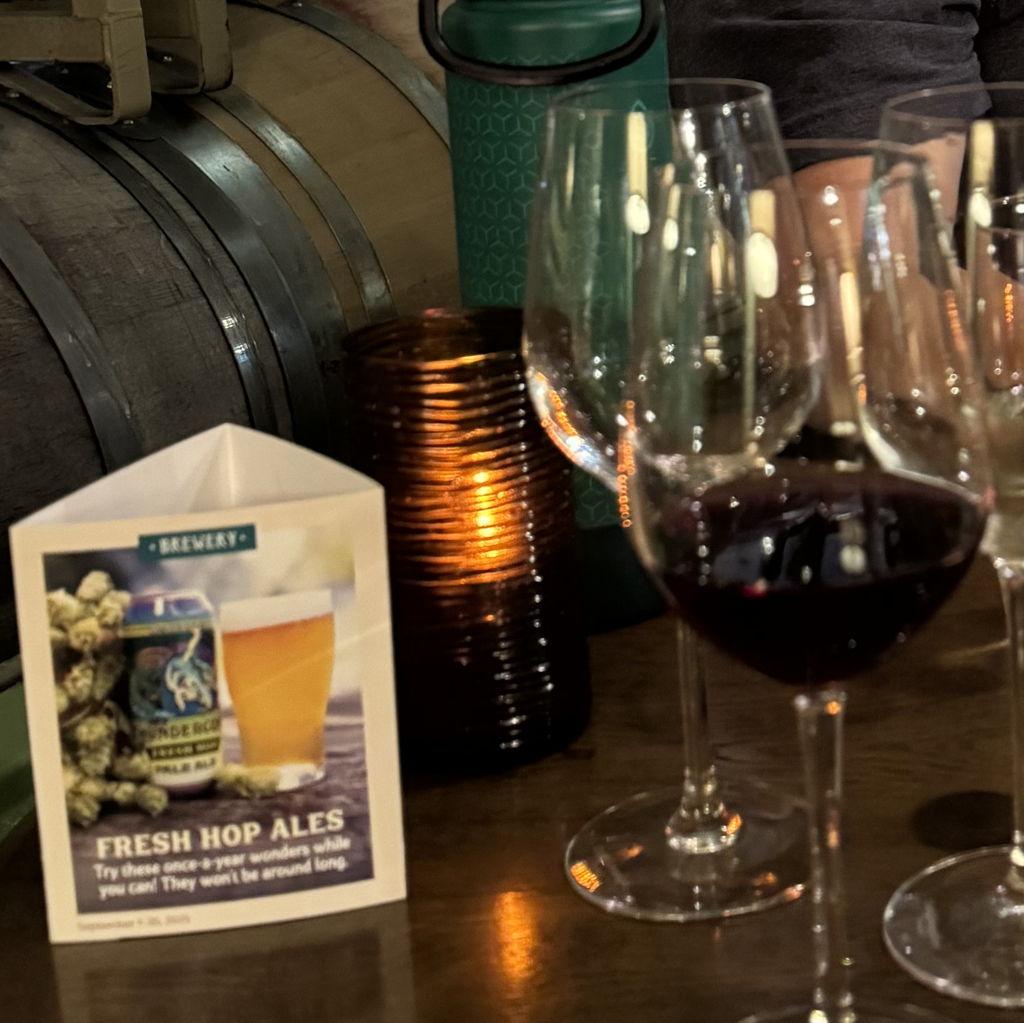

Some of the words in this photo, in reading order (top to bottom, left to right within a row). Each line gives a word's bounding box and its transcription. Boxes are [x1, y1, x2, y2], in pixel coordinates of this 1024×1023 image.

[159, 530, 238, 555] BREWERY
[95, 830, 193, 860] FRESH
[200, 822, 262, 851] HOP
[269, 809, 345, 842] ALES
[92, 863, 119, 881] Try
[121, 858, 161, 877] these
[162, 852, 246, 874] once-a-year
[249, 841, 310, 864] wonders
[312, 835, 352, 854] while
[99, 883, 126, 901] you
[128, 878, 158, 896] can!
[160, 873, 197, 893] They
[201, 868, 240, 888] won't
[240, 866, 260, 883] be
[262, 858, 312, 882] around
[314, 854, 350, 873] long.
